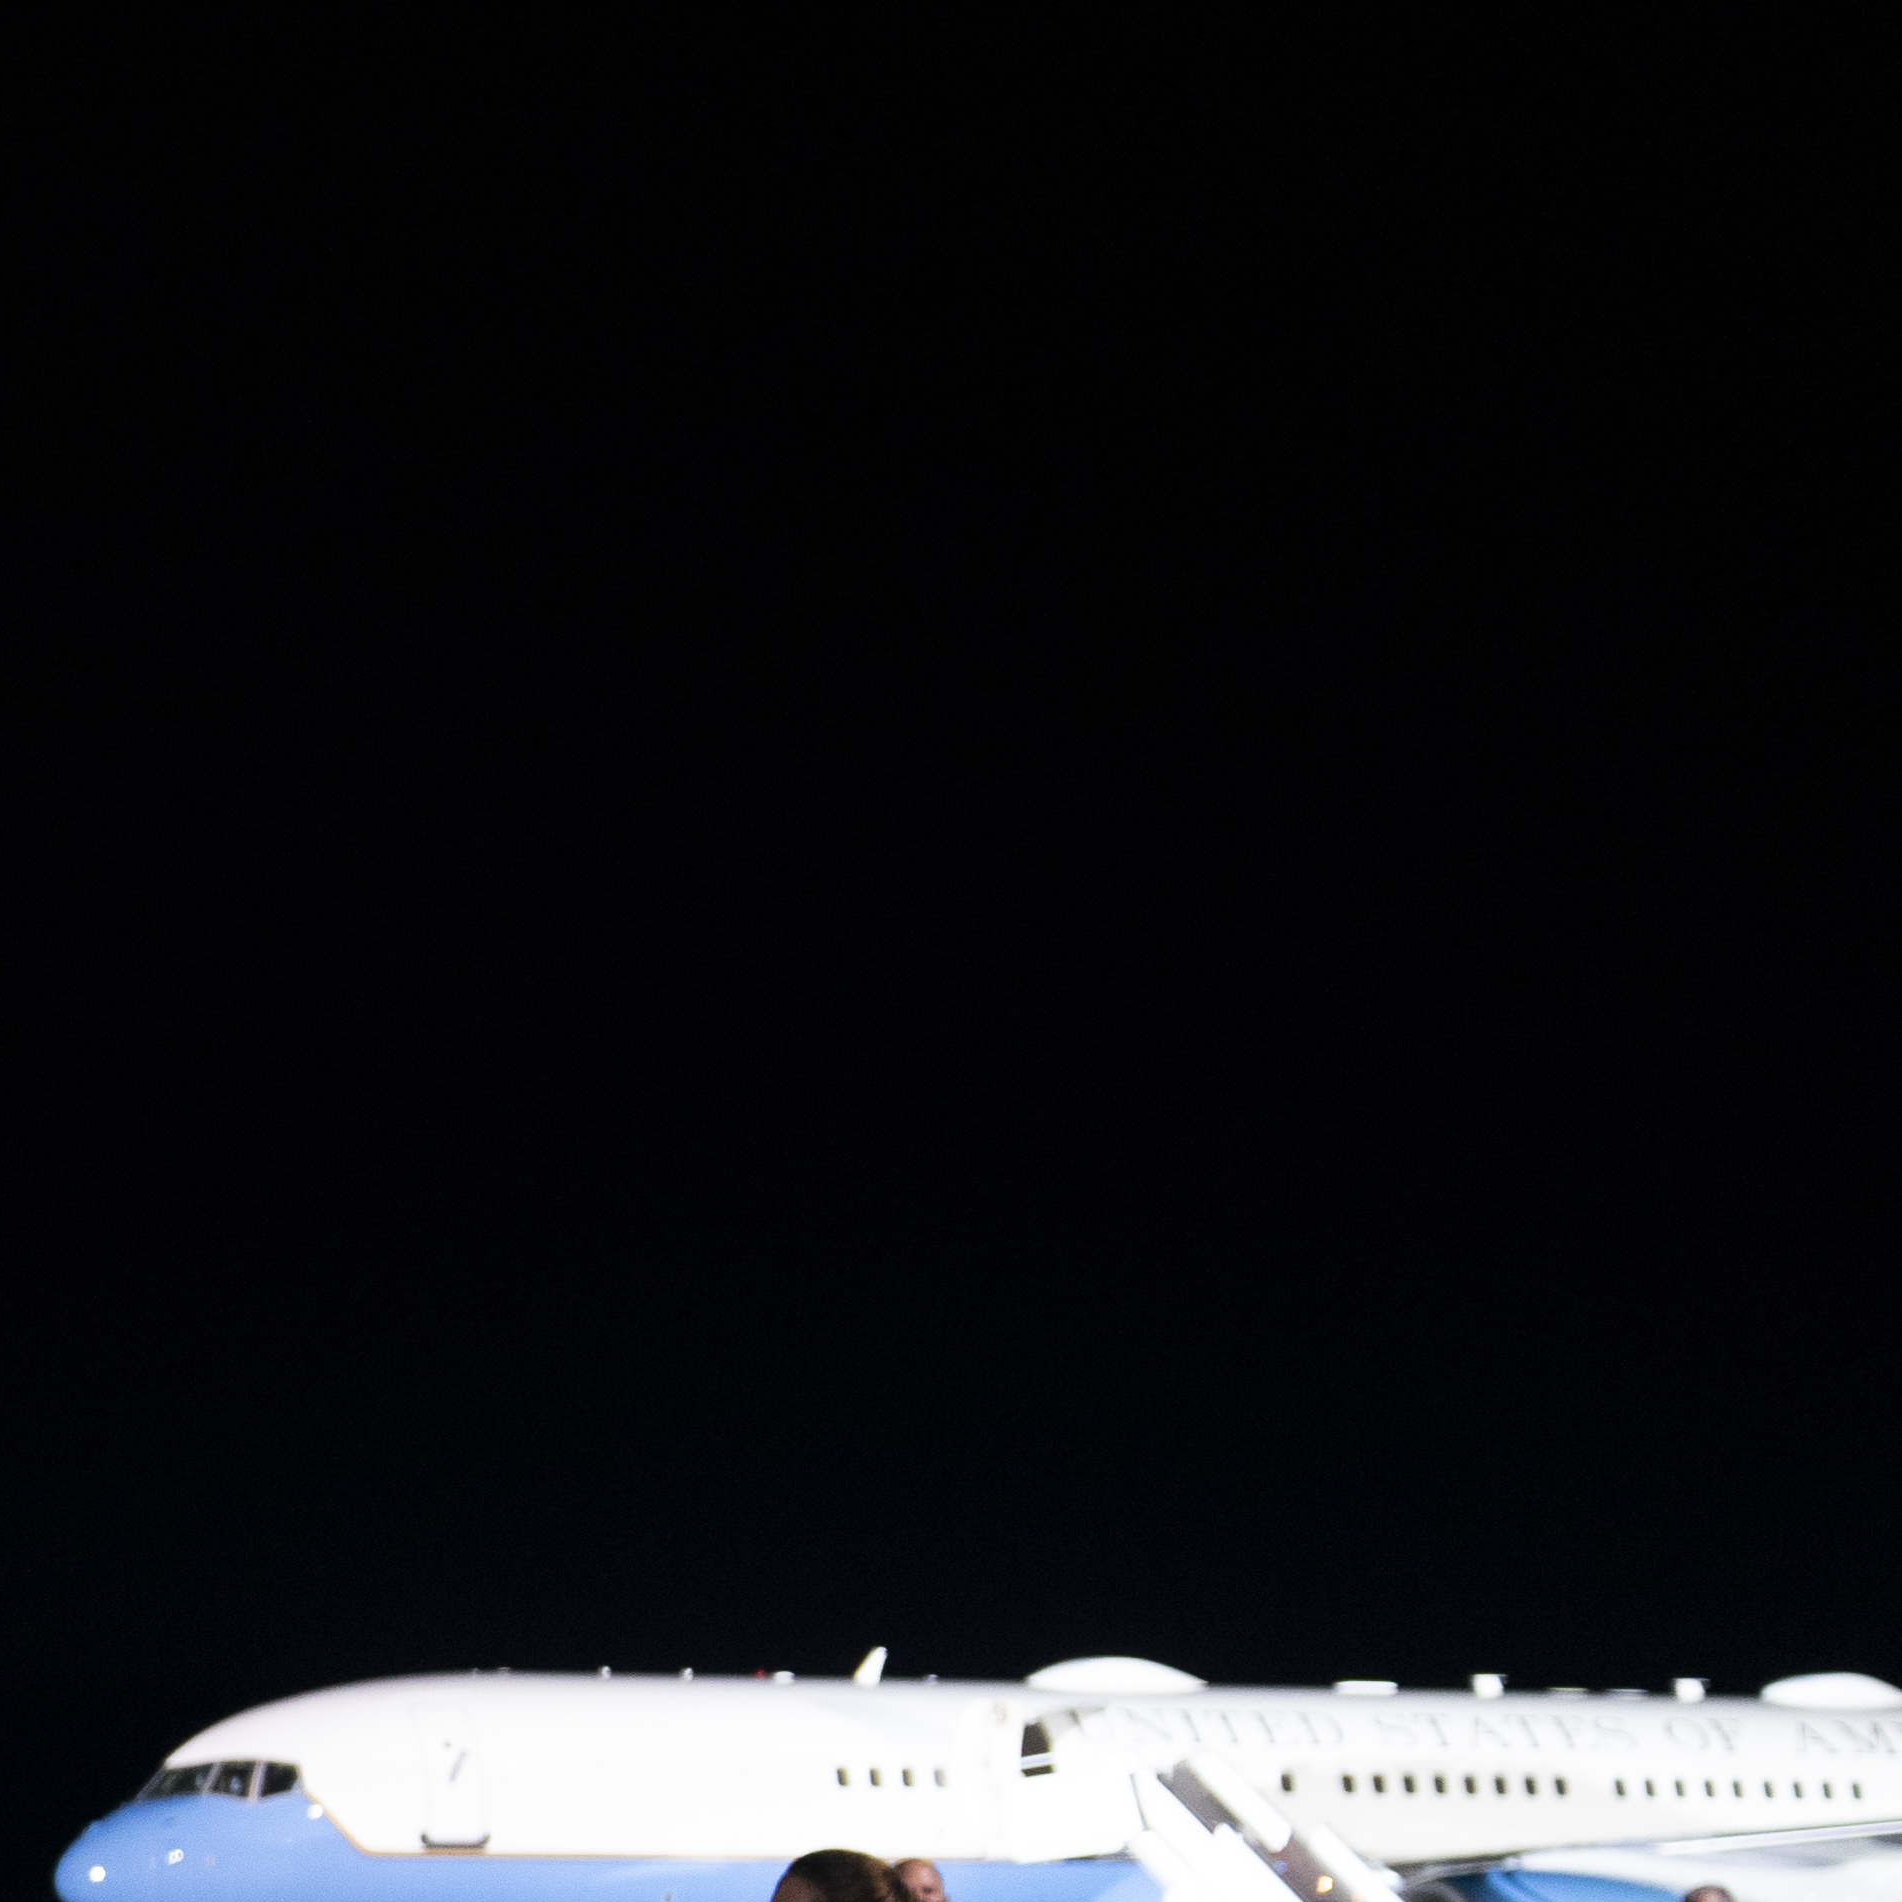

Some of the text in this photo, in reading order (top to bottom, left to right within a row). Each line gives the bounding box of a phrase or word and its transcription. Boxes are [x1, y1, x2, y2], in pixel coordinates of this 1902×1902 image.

[1069, 1704, 1344, 1744] UNITED
[1374, 1710, 1639, 1748] STATES
[1661, 1714, 1742, 1752] OF
